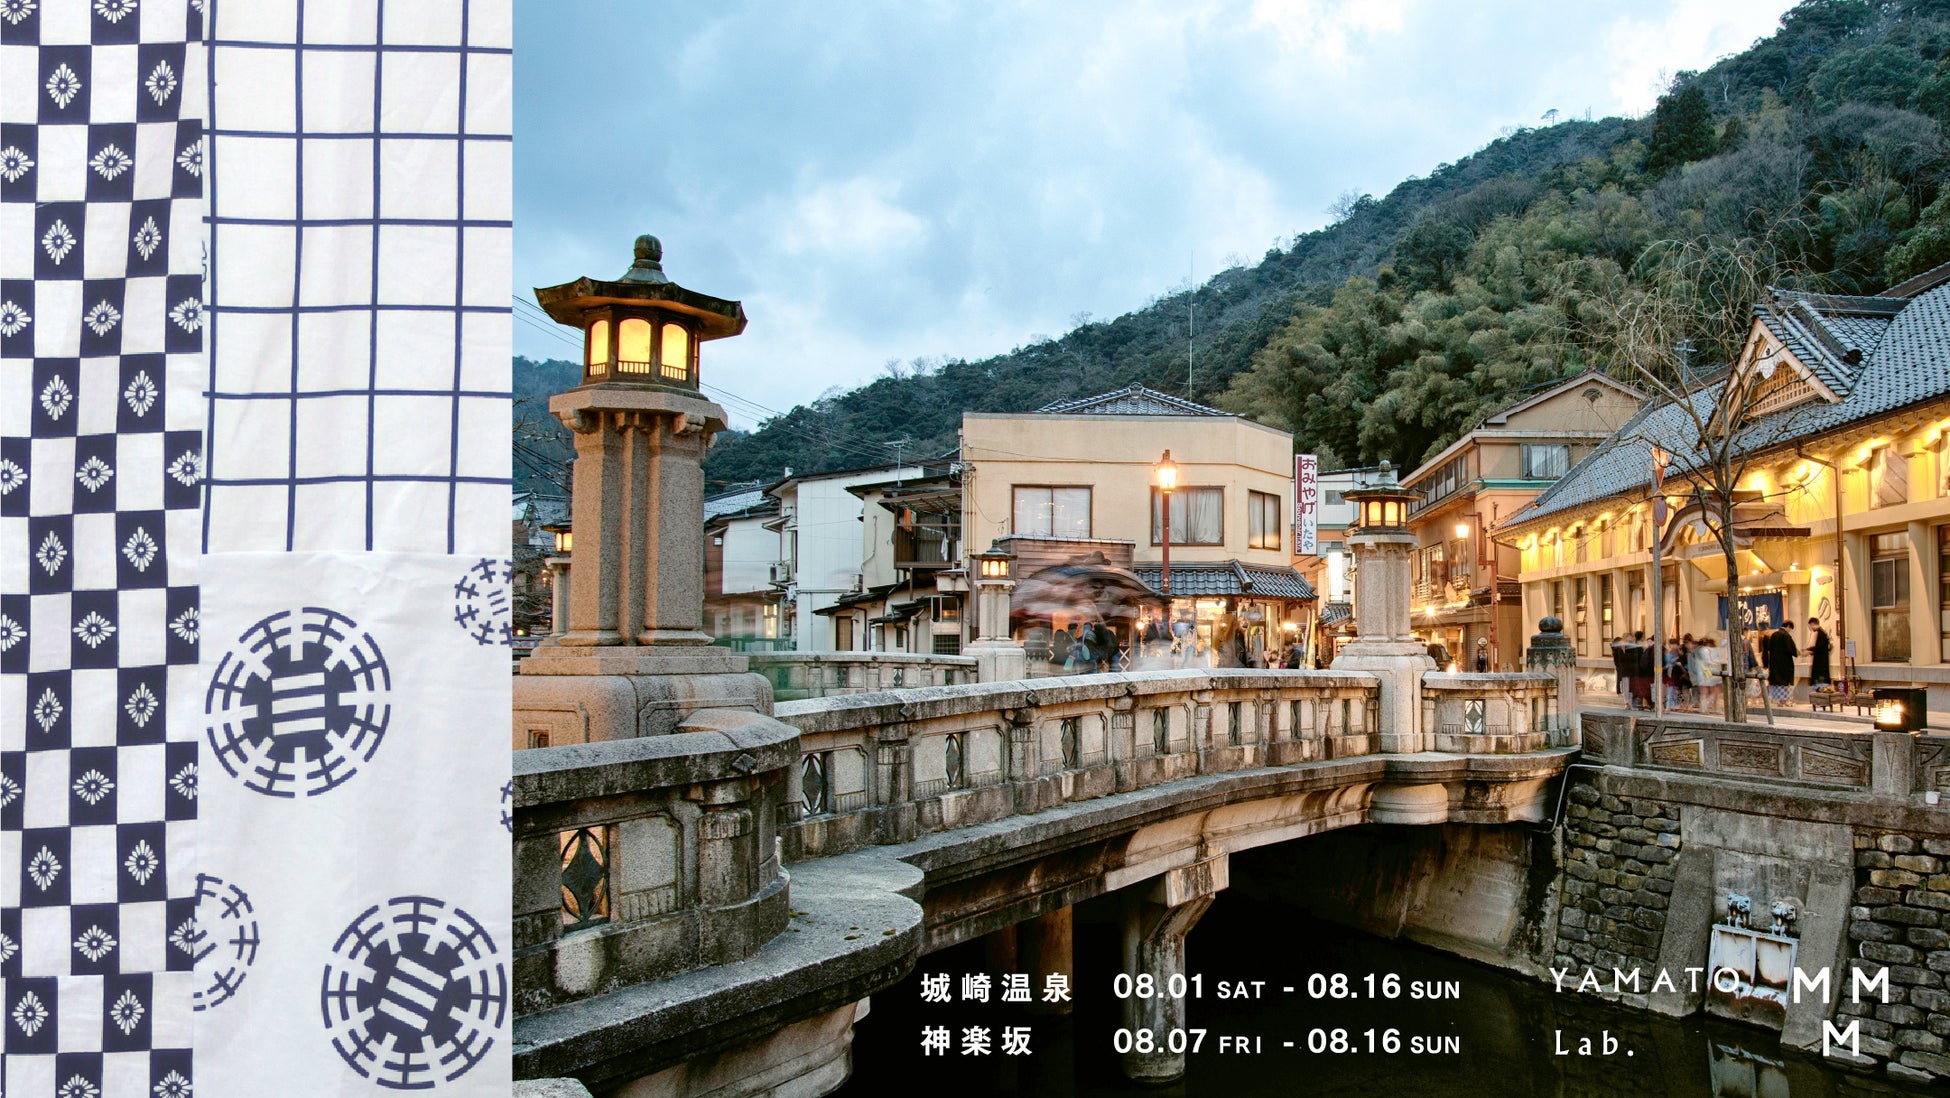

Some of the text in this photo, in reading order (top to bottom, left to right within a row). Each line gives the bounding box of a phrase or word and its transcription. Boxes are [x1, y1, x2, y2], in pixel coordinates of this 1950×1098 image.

[1302, 458, 1317, 550] おみやげ いたや
